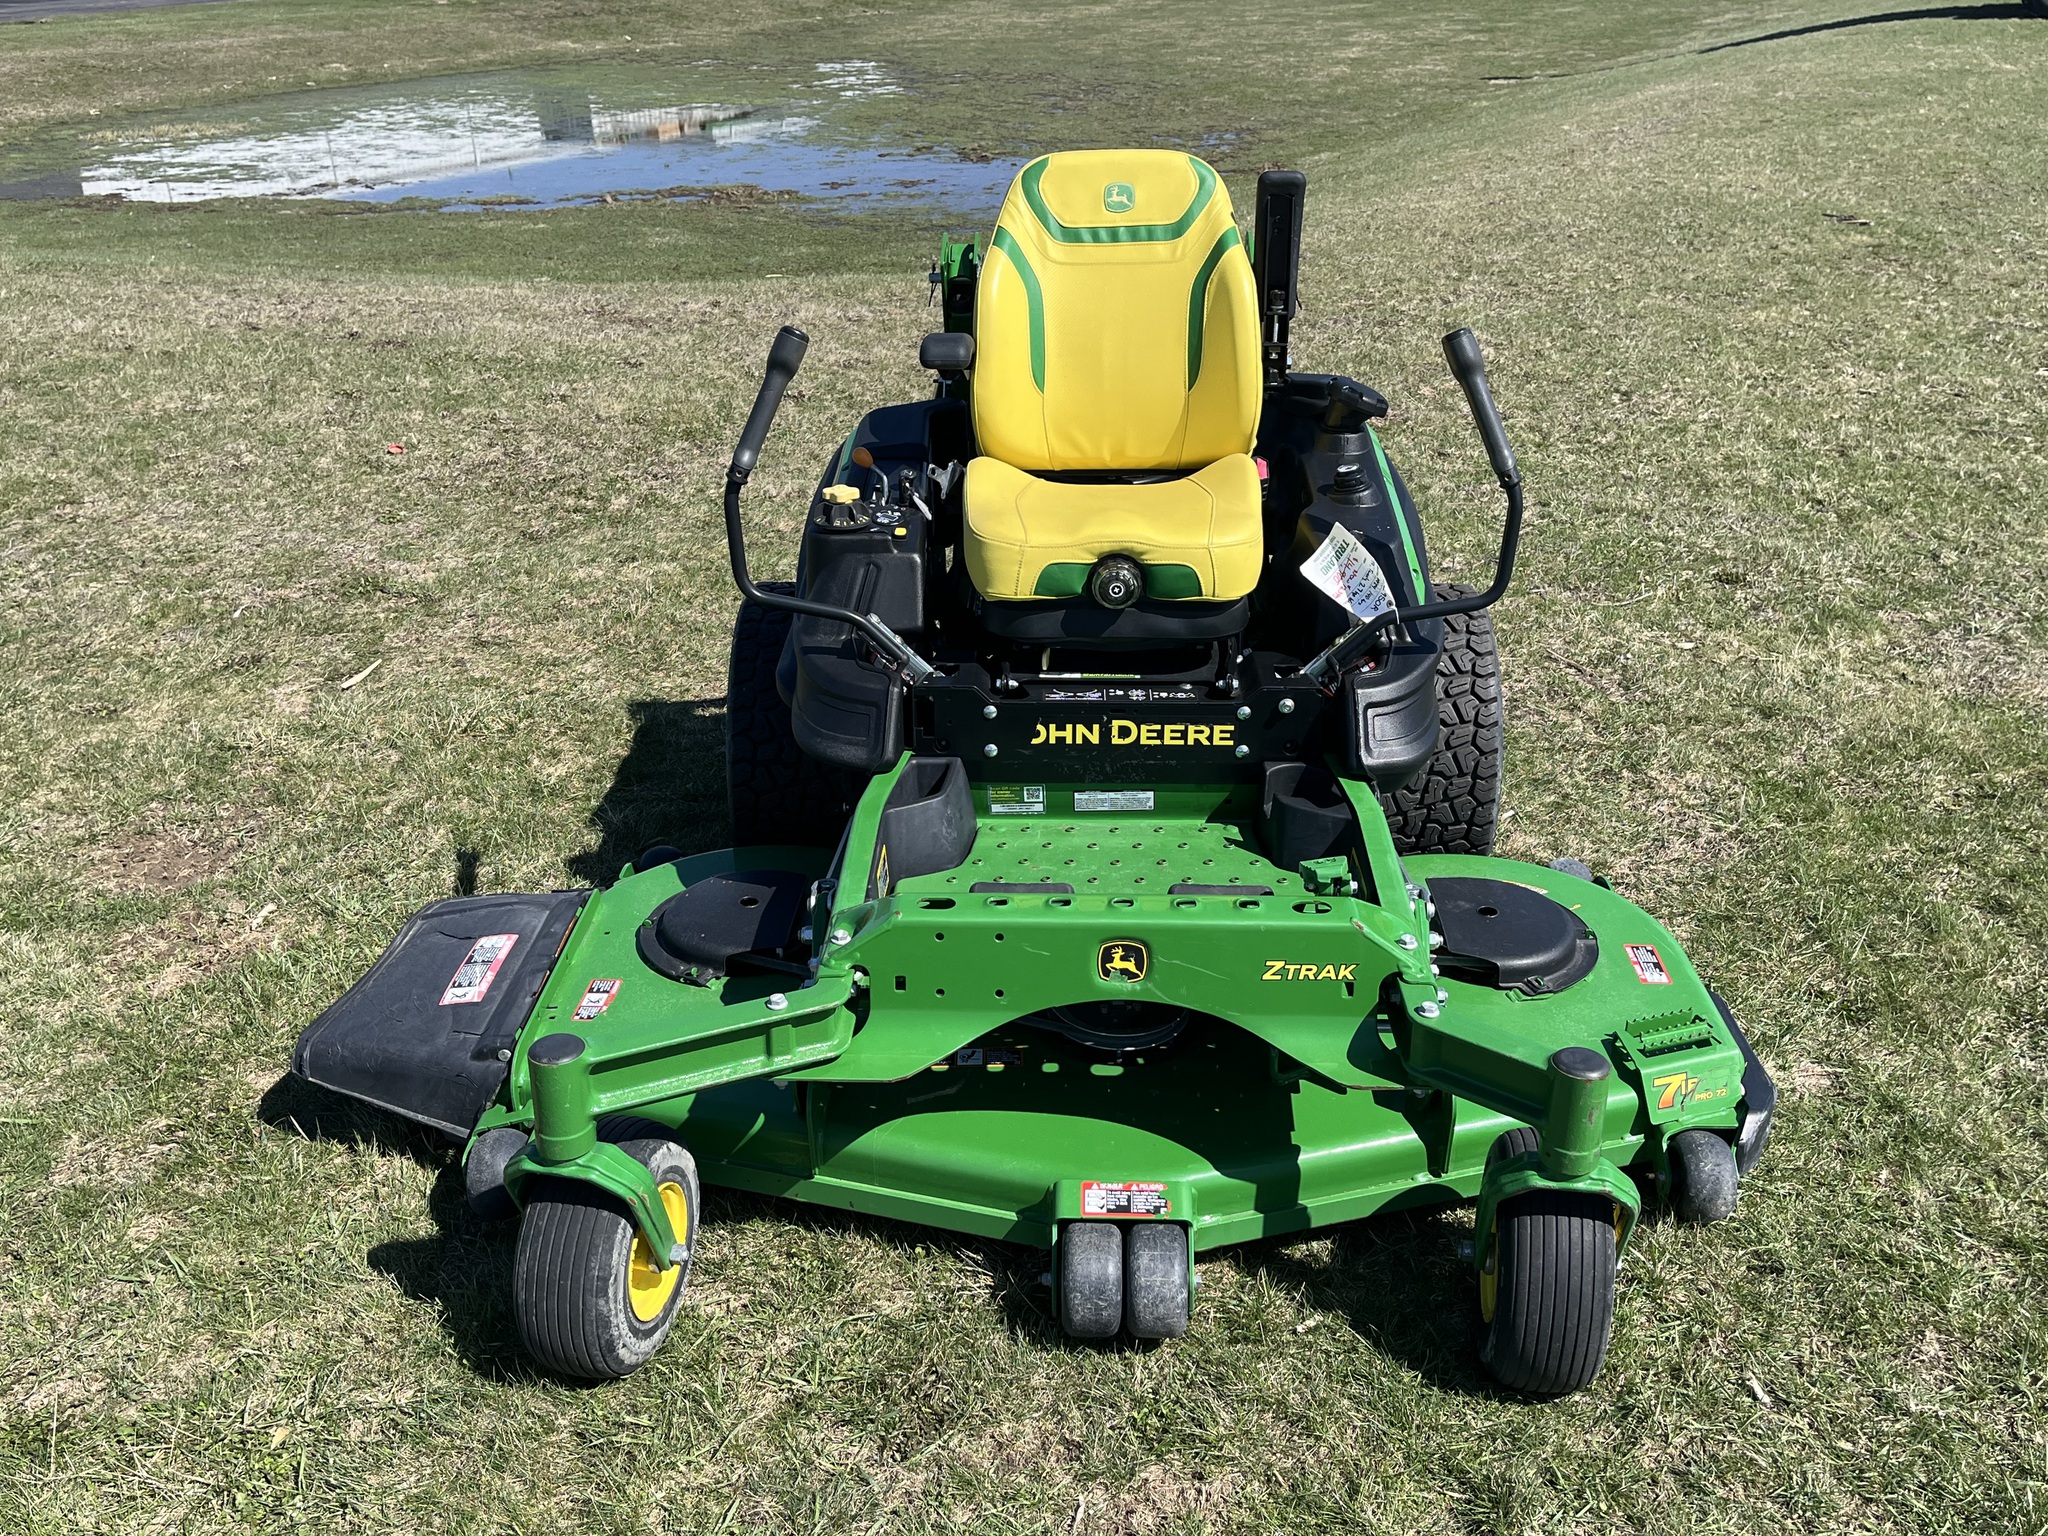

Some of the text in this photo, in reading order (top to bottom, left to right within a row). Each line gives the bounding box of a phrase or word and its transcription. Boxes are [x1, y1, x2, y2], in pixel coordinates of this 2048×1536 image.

[1320, 539, 1350, 576] TRULAND
[1111, 719, 1235, 746] DEERE
[1261, 960, 1359, 981] ZTRAK
[1695, 1088, 1727, 1102] PRO 72
